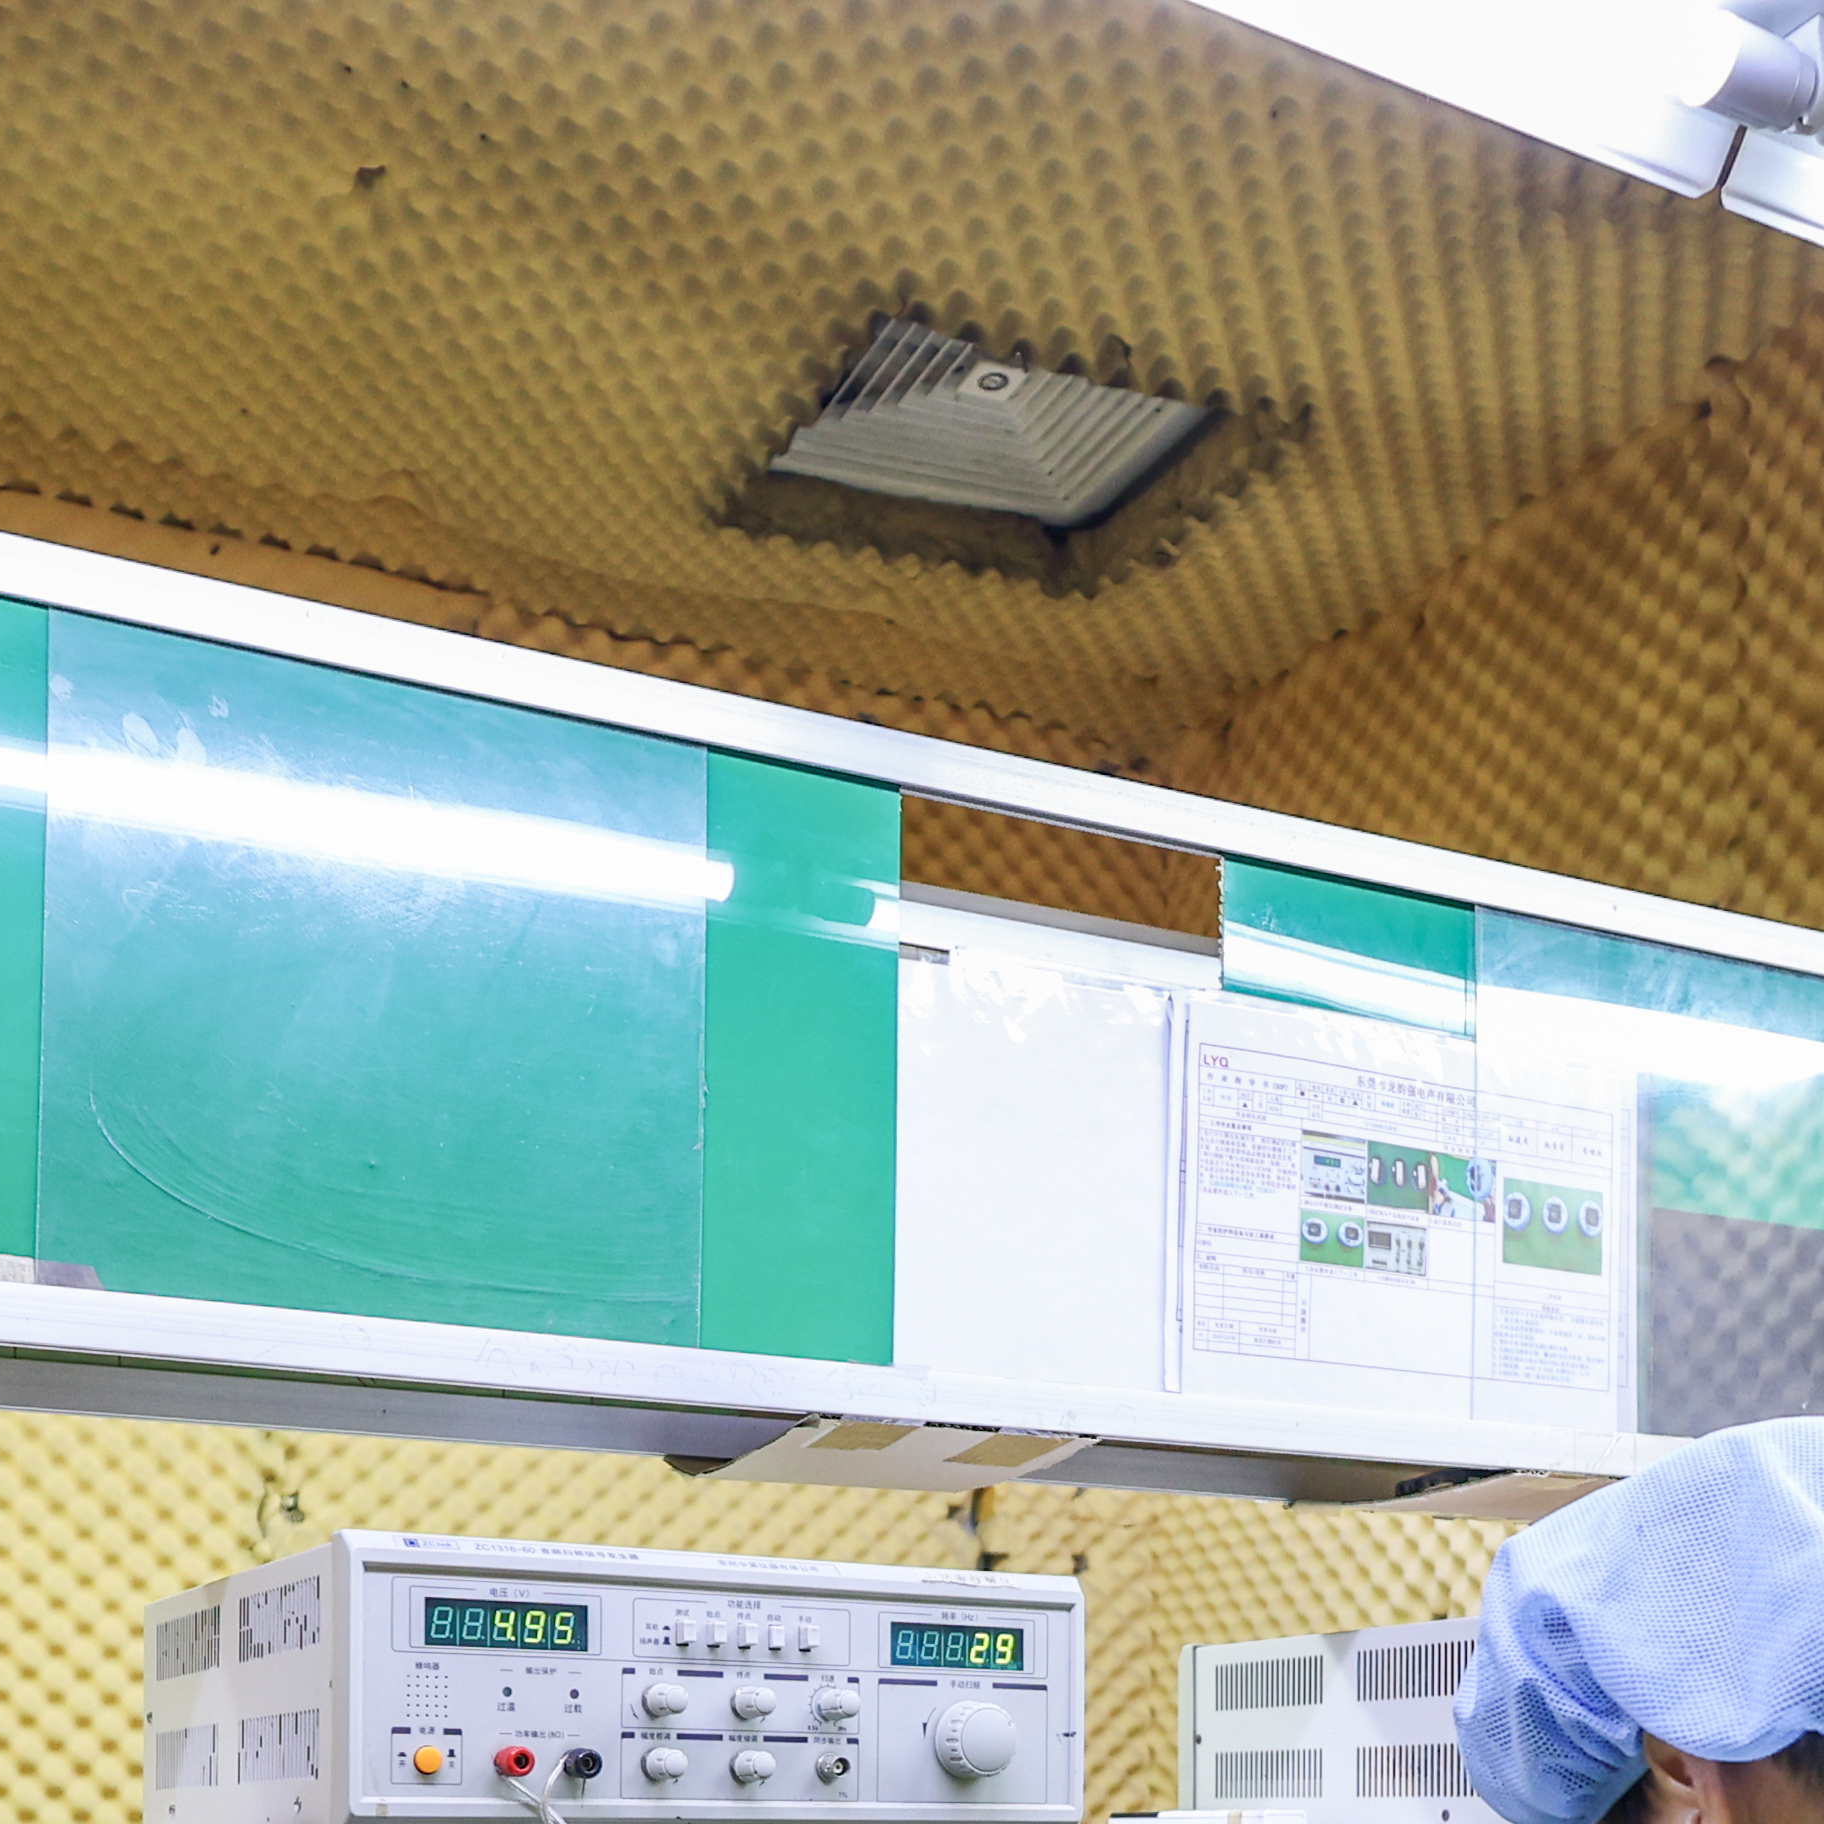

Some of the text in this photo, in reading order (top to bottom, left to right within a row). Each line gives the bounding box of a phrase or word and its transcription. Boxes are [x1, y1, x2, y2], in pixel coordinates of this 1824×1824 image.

[1203, 1053, 1229, 1069] LYQ
[727, 1600, 762, 1610] 功能选择
[497, 1702, 516, 1712] 过温
[564, 1703, 583, 1714] 过载
